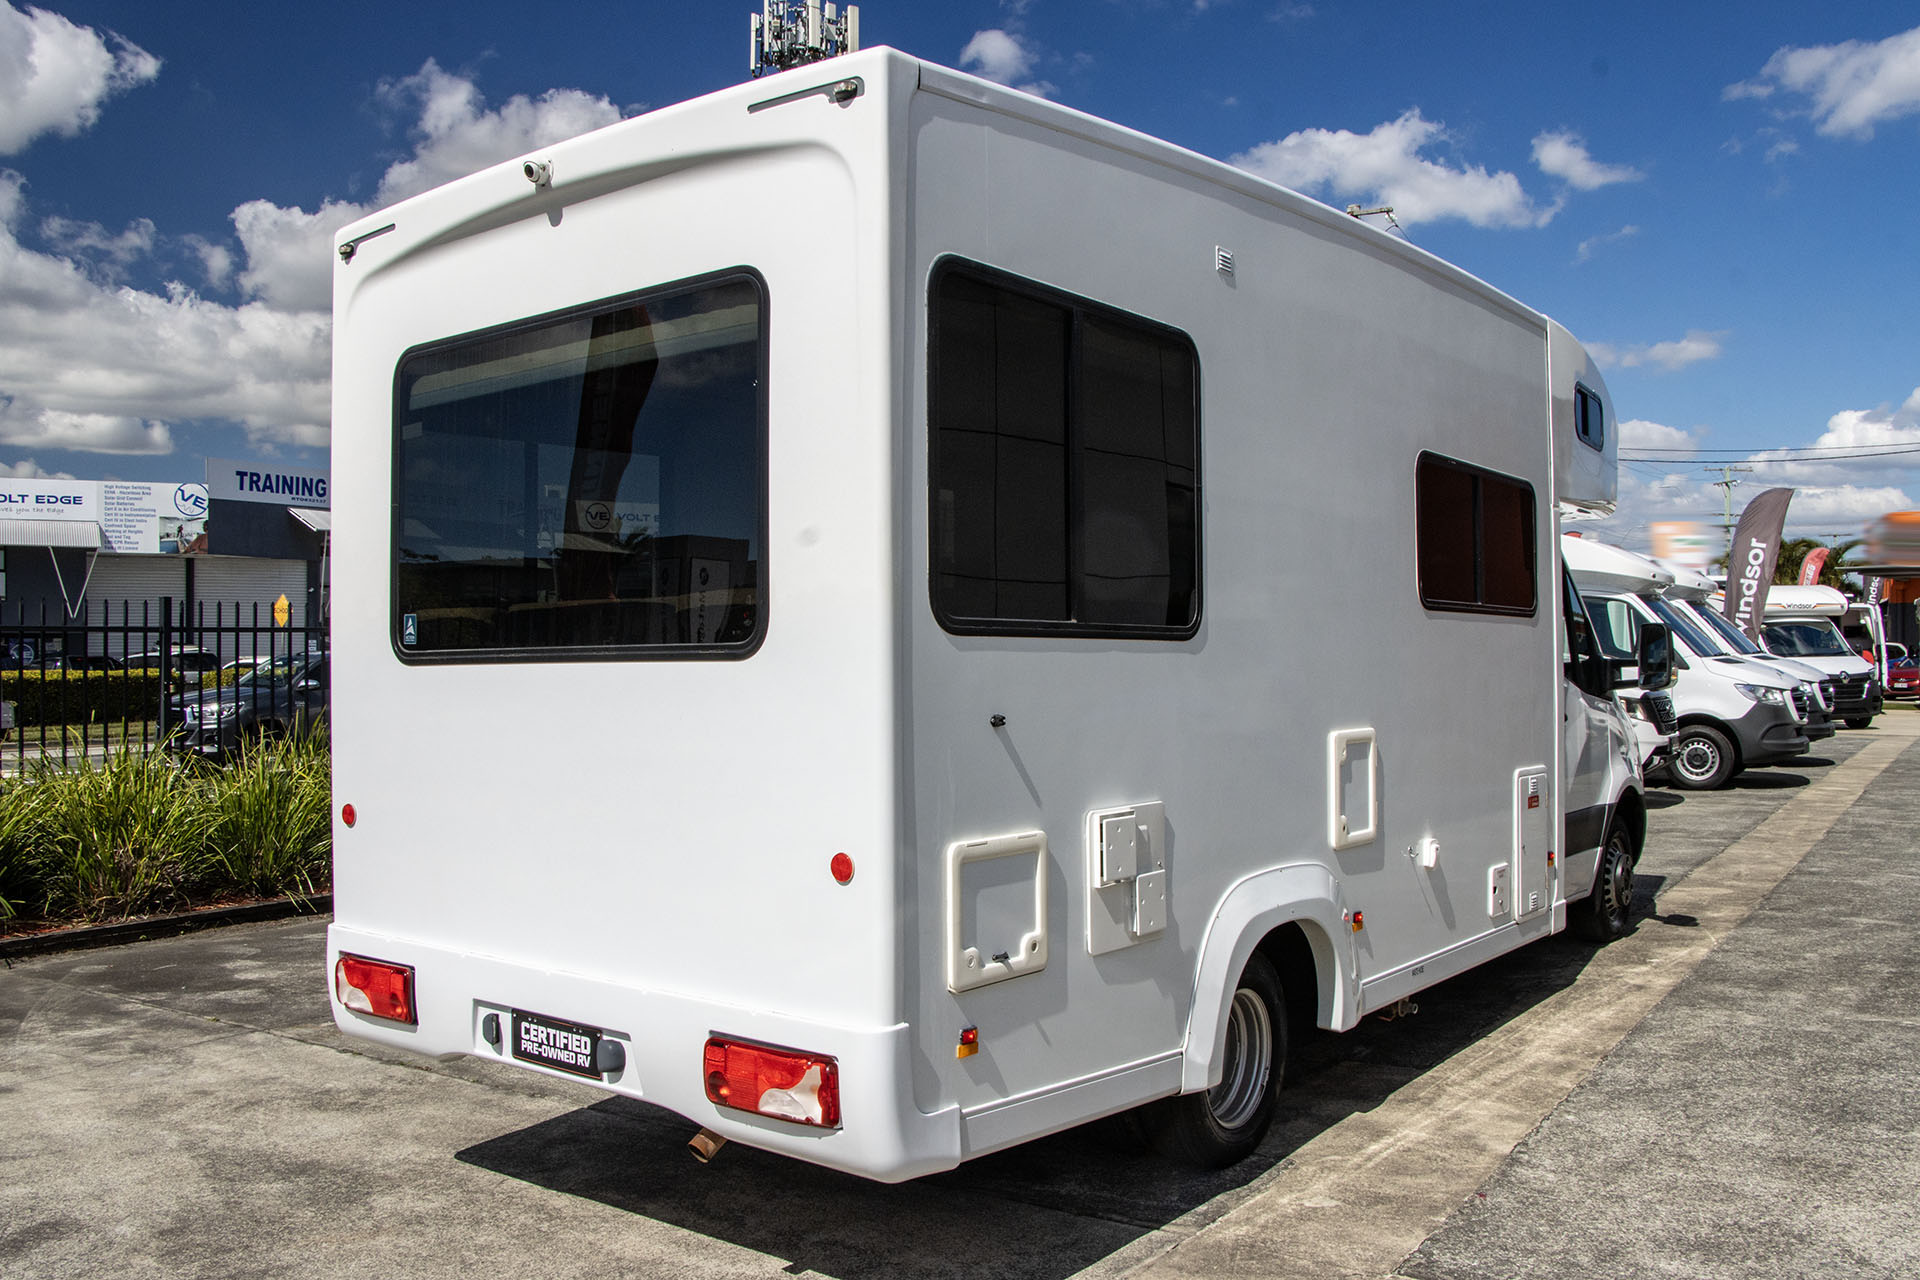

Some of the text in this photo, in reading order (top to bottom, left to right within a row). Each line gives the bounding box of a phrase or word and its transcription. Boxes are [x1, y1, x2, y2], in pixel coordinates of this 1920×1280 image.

[235, 470, 327, 498] TRAINING
[0, 494, 83, 505] OLT EDGE
[616, 512, 651, 522] VOLT
[520, 1021, 591, 1055] CERTIFIED
[521, 1039, 591, 1068] PRE-OWNED RV
